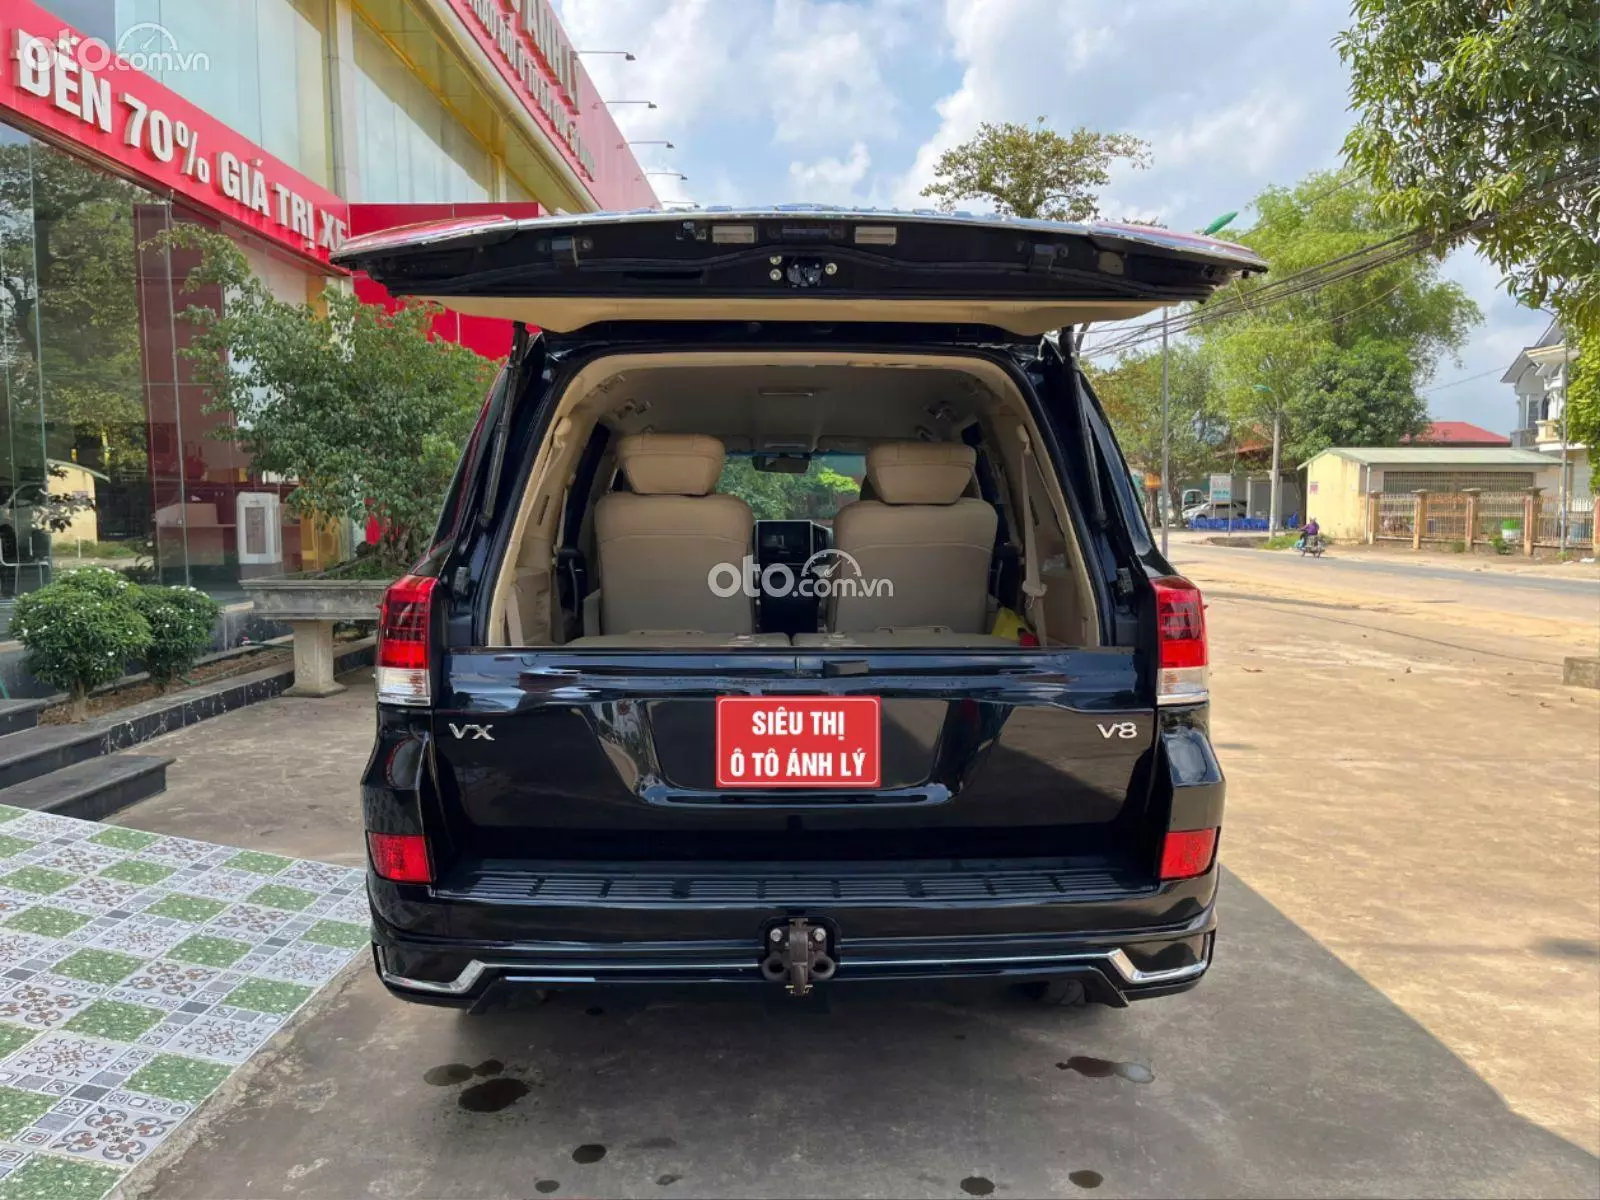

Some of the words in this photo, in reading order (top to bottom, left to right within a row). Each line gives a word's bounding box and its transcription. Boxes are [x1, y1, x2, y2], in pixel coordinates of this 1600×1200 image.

[121, 92, 210, 184] 70%
[218, 151, 270, 217] GIÁ
[273, 182, 315, 249] TRỊ
[448, 723, 495, 740] VX
[752, 706, 803, 735] SIÊU
[810, 711, 845, 741] THỊ
[1097, 722, 1137, 738] V8
[730, 747, 745, 777] Ô
[751, 747, 779, 777] TÔ
[786, 748, 833, 777] ÁNH
[840, 748, 866, 777] LÝ
